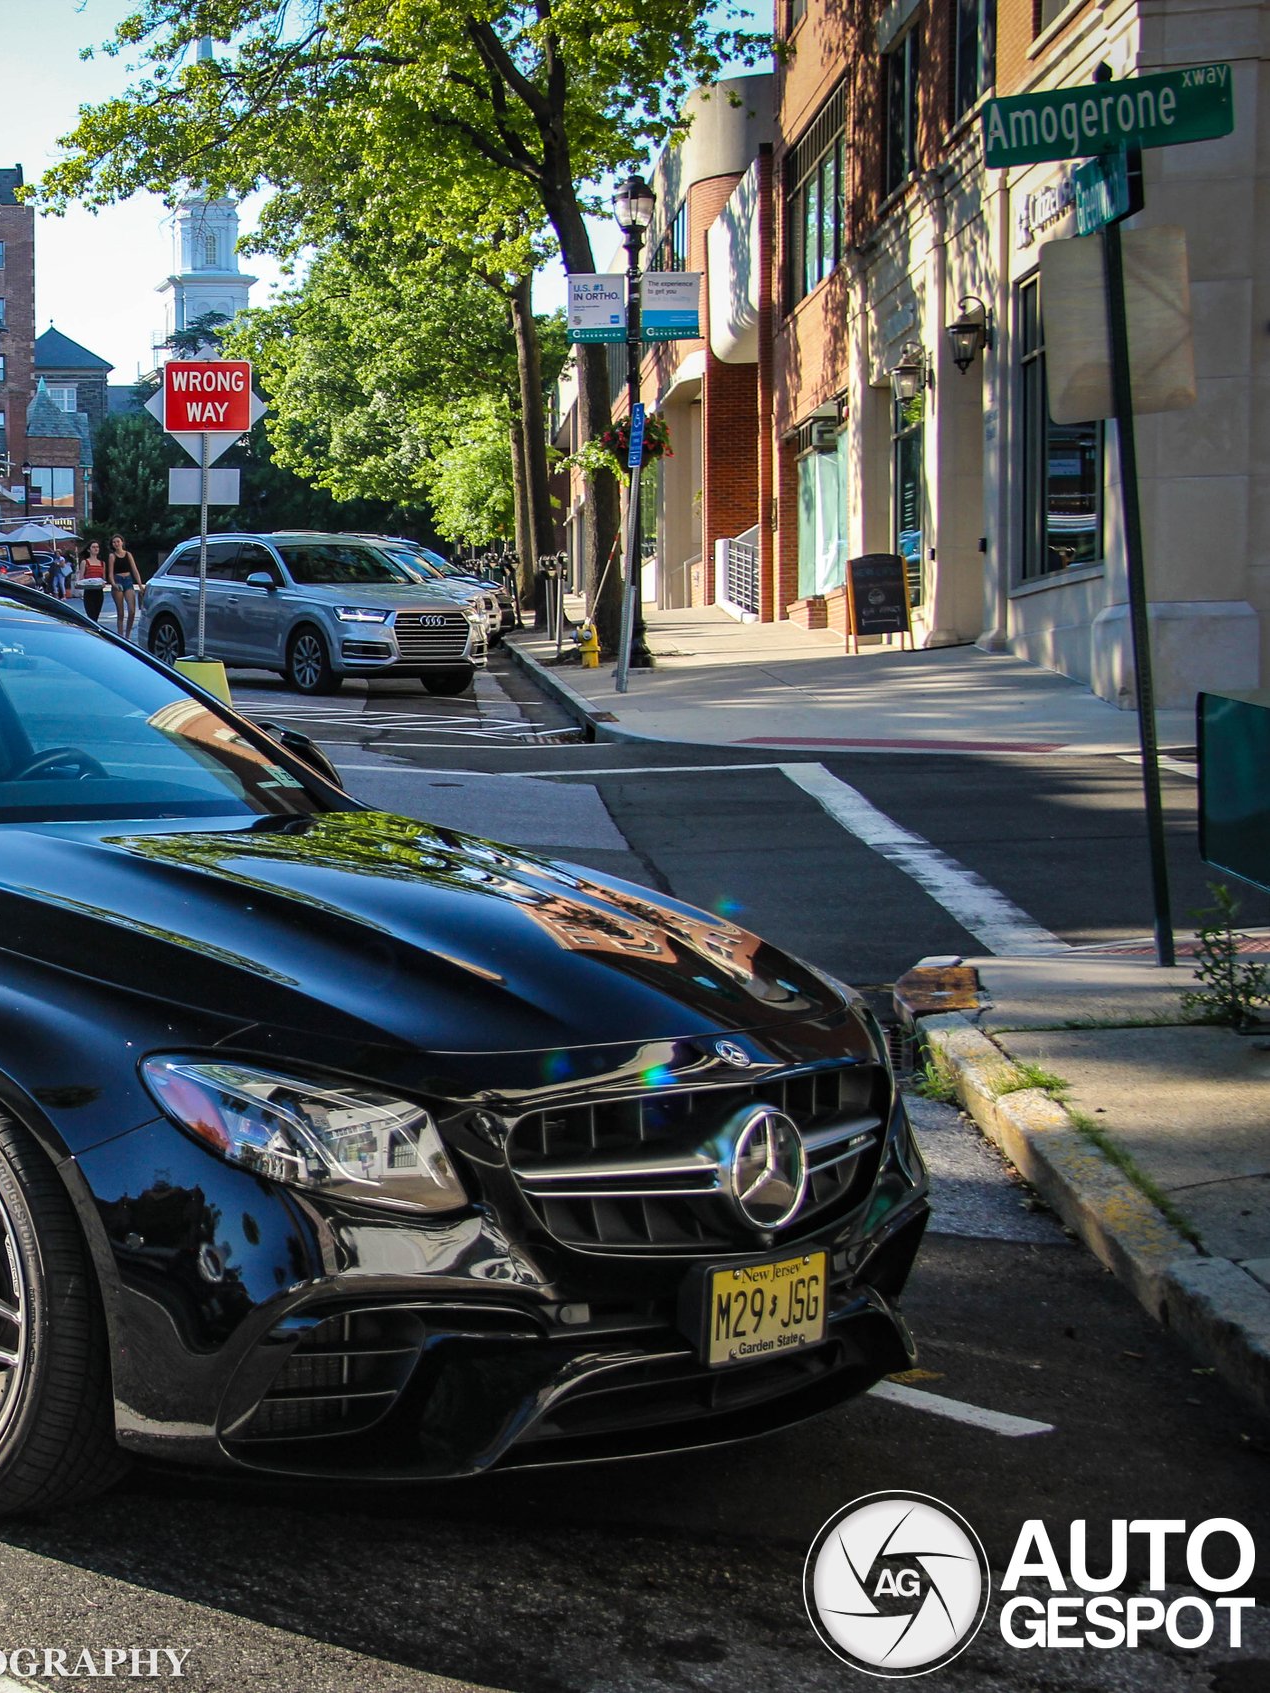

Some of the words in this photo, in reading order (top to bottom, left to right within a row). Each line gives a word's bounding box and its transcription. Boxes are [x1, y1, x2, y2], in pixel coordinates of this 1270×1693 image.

[986, 86, 1177, 156] Amogerone
[1182, 65, 1229, 88] xway
[573, 283, 591, 293] U.S.
[593, 283, 604, 292] #1
[655, 288, 665, 296] get
[660, 280, 693, 289] experience
[573, 293, 583, 301] IN
[585, 292, 620, 301] ORTHO.
[171, 371, 244, 392] WRONG
[186, 402, 229, 422] WAY
[741, 1267, 770, 1284] New
[770, 1262, 802, 1282] Jersey
[715, 1286, 765, 1341] M29
[780, 1275, 820, 1328] JSG
[738, 1339, 774, 1355] Garden
[776, 1332, 799, 1347] State
